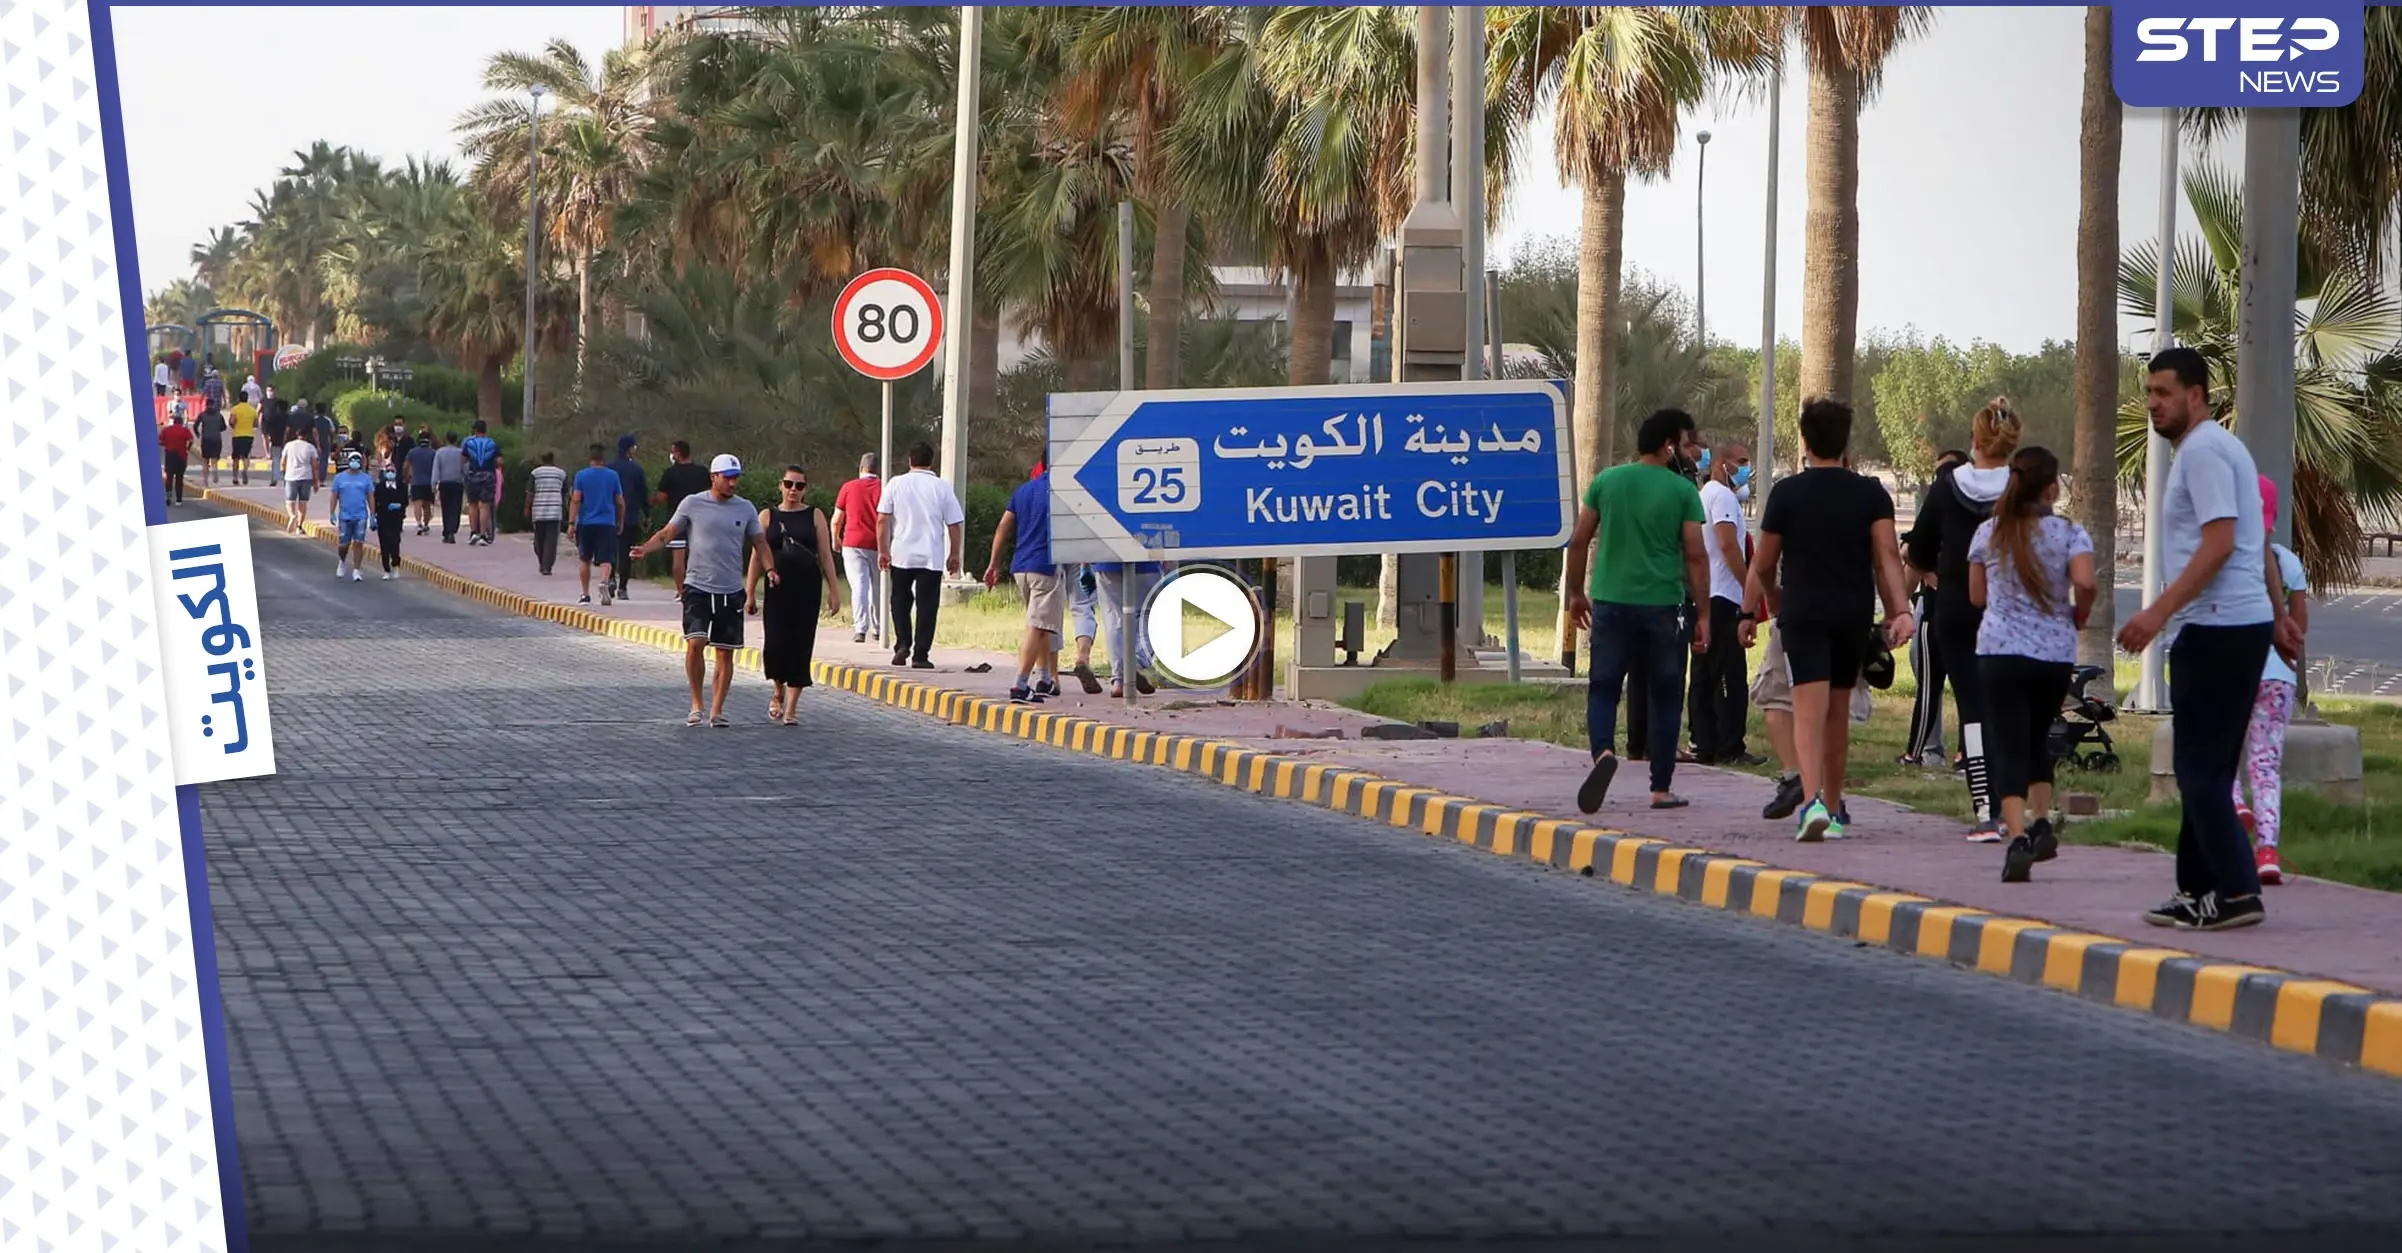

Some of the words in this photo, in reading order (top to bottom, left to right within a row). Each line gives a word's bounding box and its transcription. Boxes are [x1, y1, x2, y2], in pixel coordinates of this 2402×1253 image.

[857, 303, 919, 344] 80
[1213, 411, 1383, 469] الكويت
[1404, 413, 1541, 465] مدينة
[1132, 467, 1186, 504] 25
[1246, 484, 1392, 523] Kuwait
[1416, 480, 1504, 524] City
